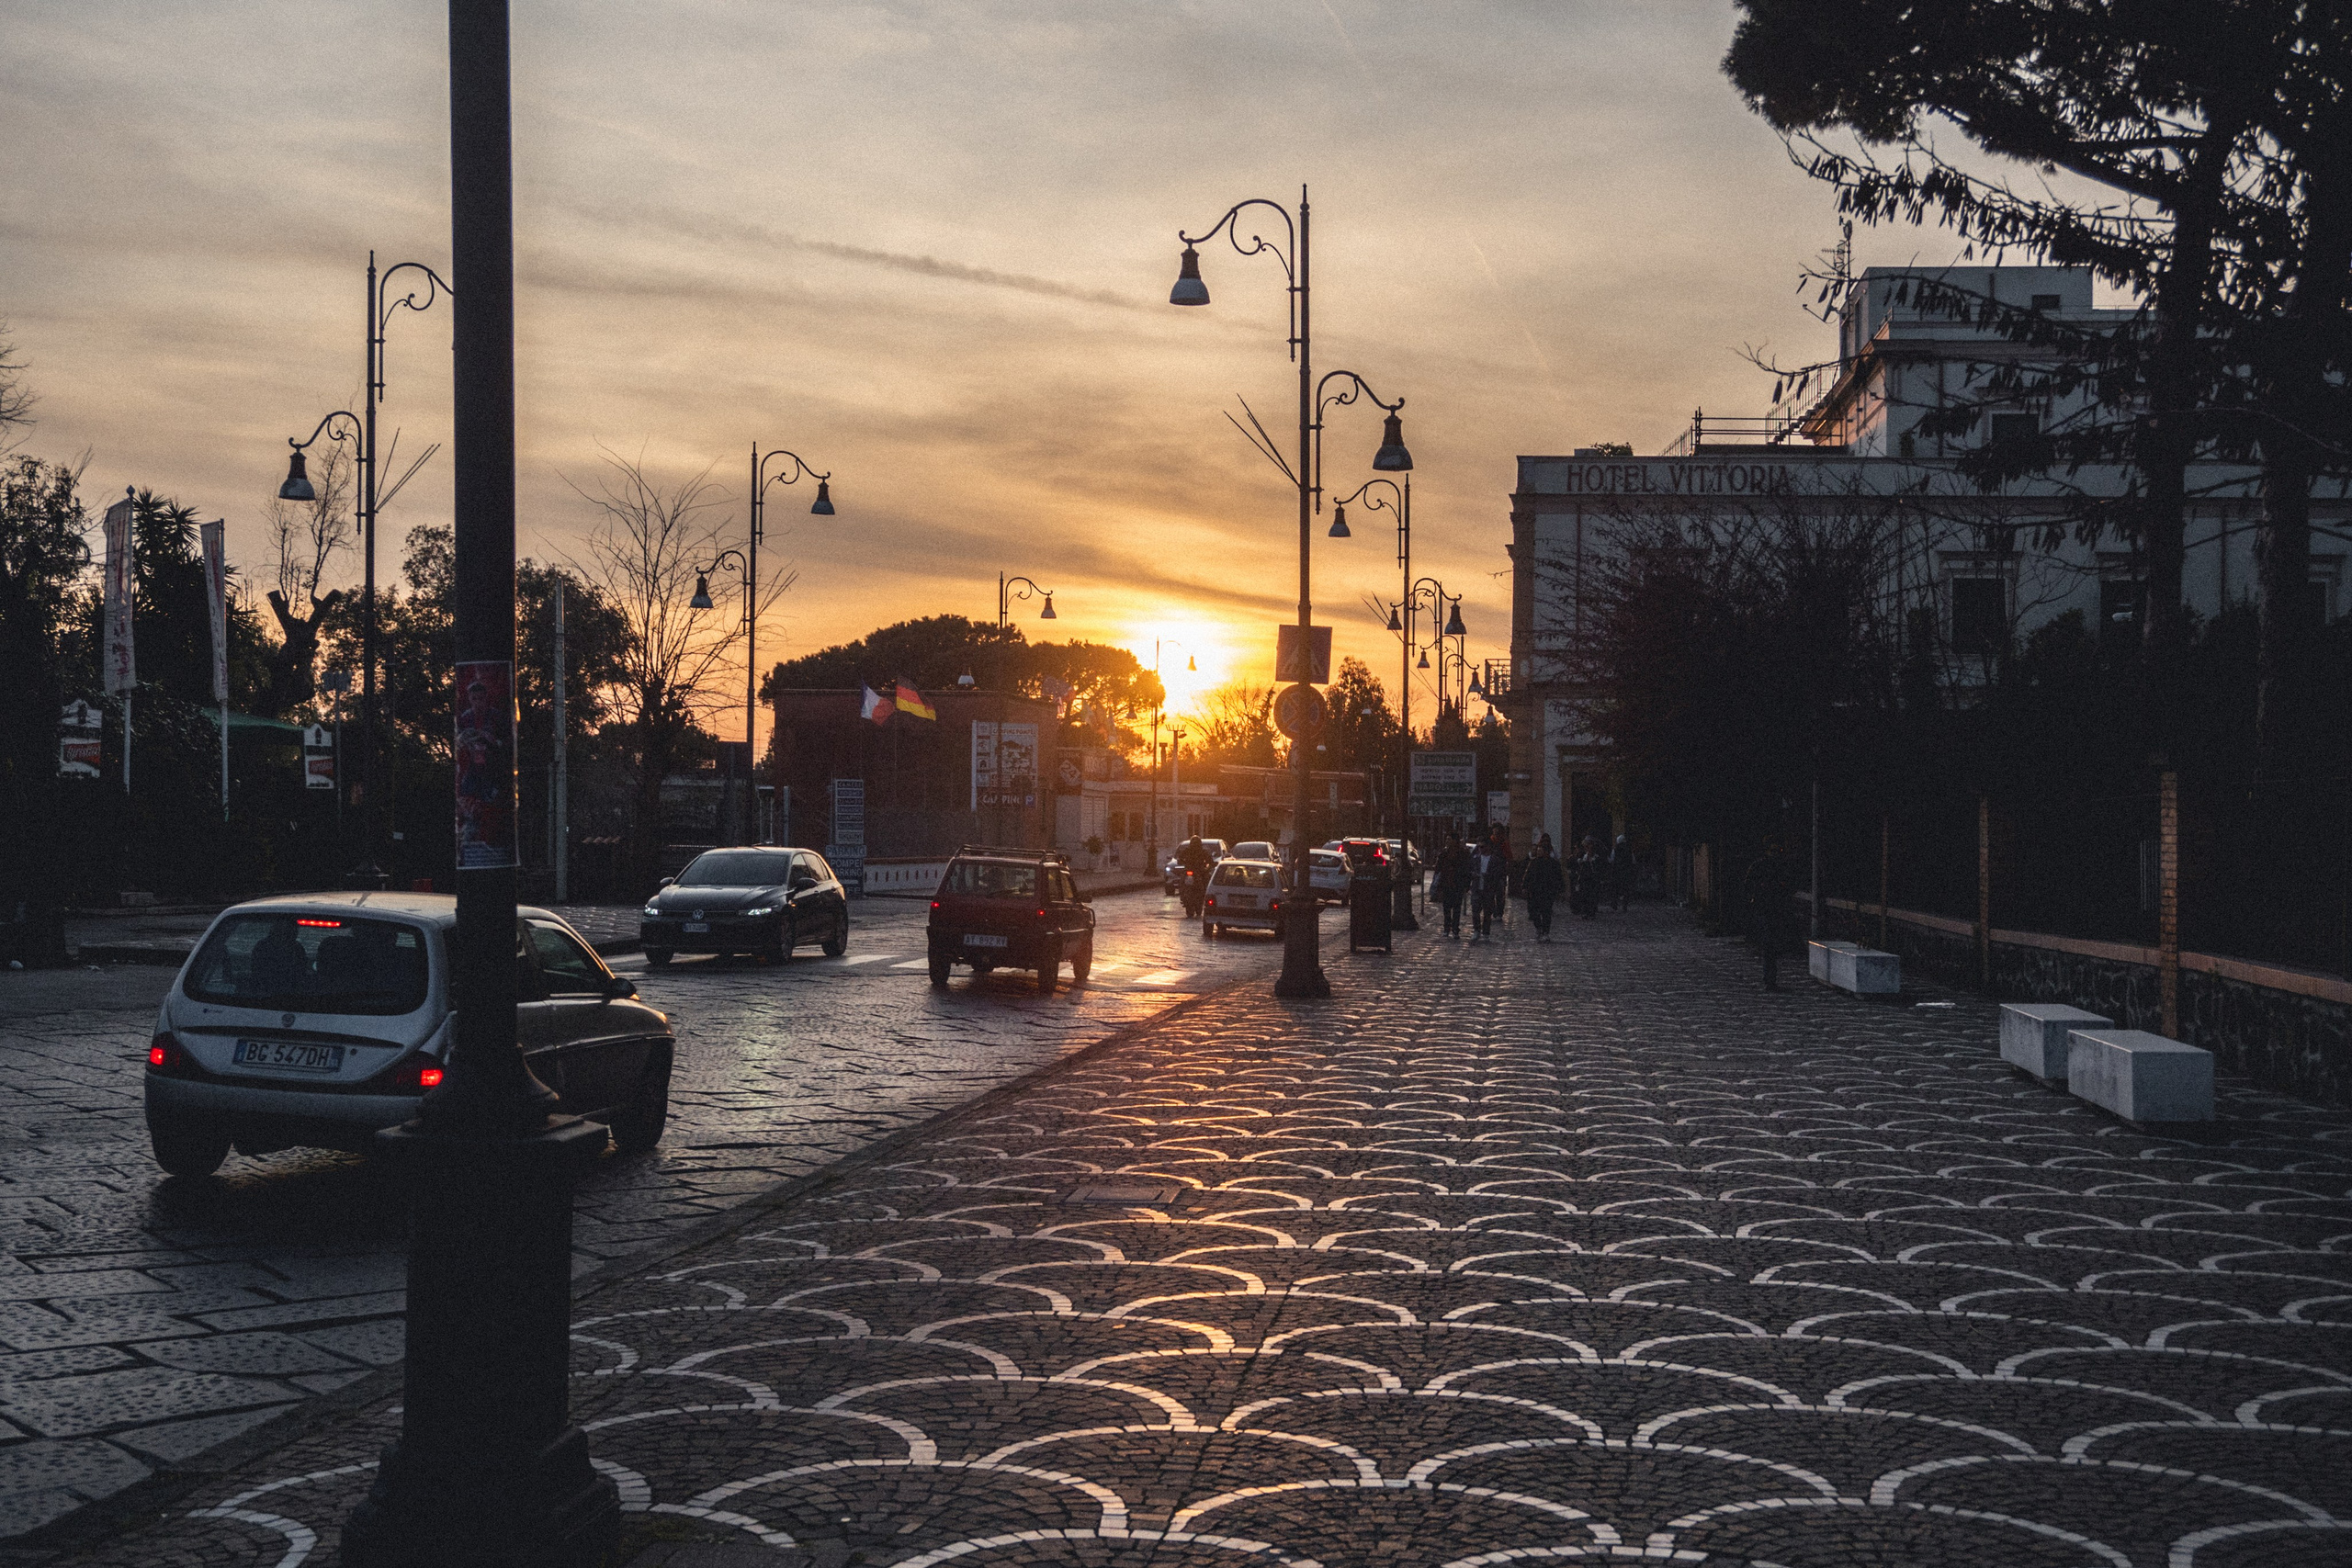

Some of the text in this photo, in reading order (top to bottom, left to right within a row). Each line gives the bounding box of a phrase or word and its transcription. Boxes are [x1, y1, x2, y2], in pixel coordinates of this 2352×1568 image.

[1566, 464, 1792, 494] HOTEL VITTORIA
[827, 845, 865, 856] PARKING
[831, 858, 863, 868] POMPEI
[245, 1043, 331, 1066] BG 547DH
